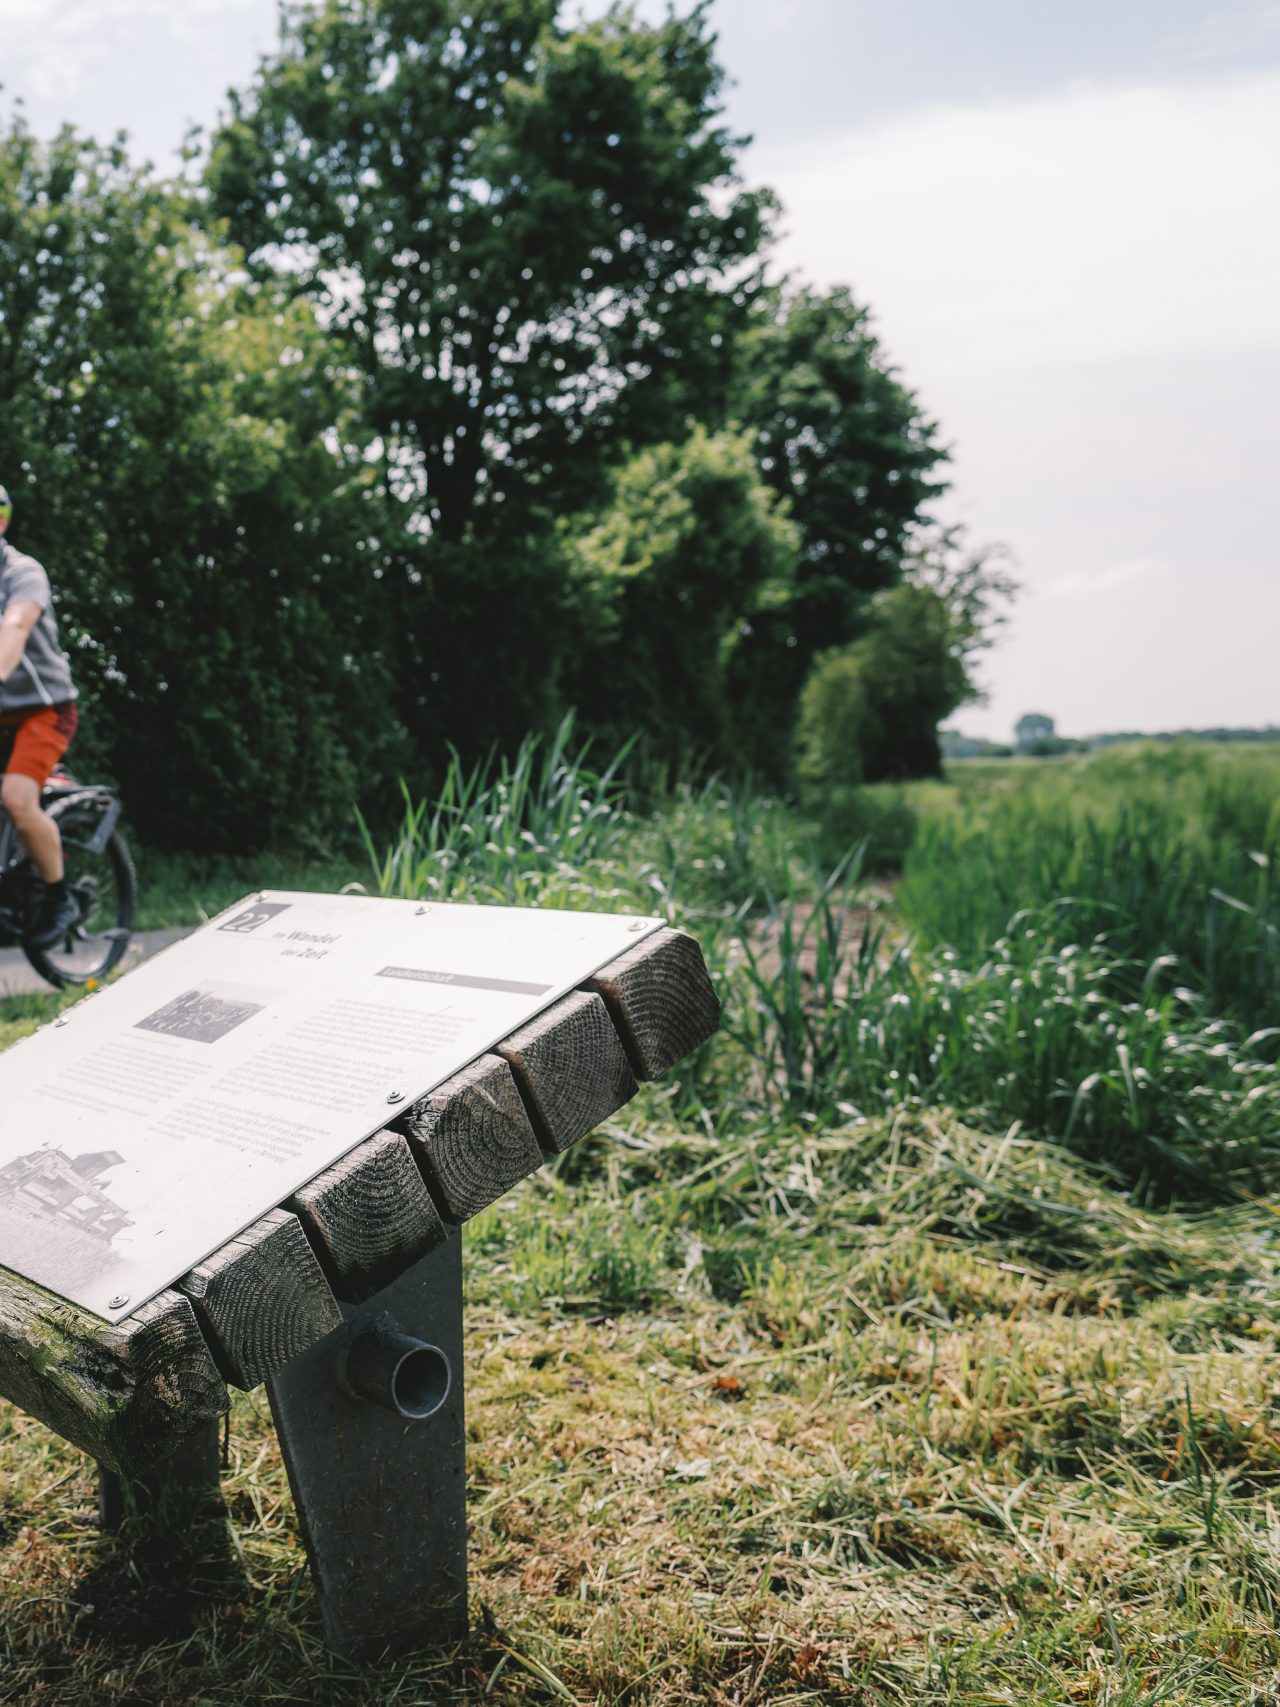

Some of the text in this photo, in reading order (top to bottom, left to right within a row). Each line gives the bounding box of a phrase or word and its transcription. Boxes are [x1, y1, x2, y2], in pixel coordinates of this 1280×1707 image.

[222, 912, 270, 932] 22
[286, 930, 342, 944] Wandel
[296, 948, 330, 960] Zeit
